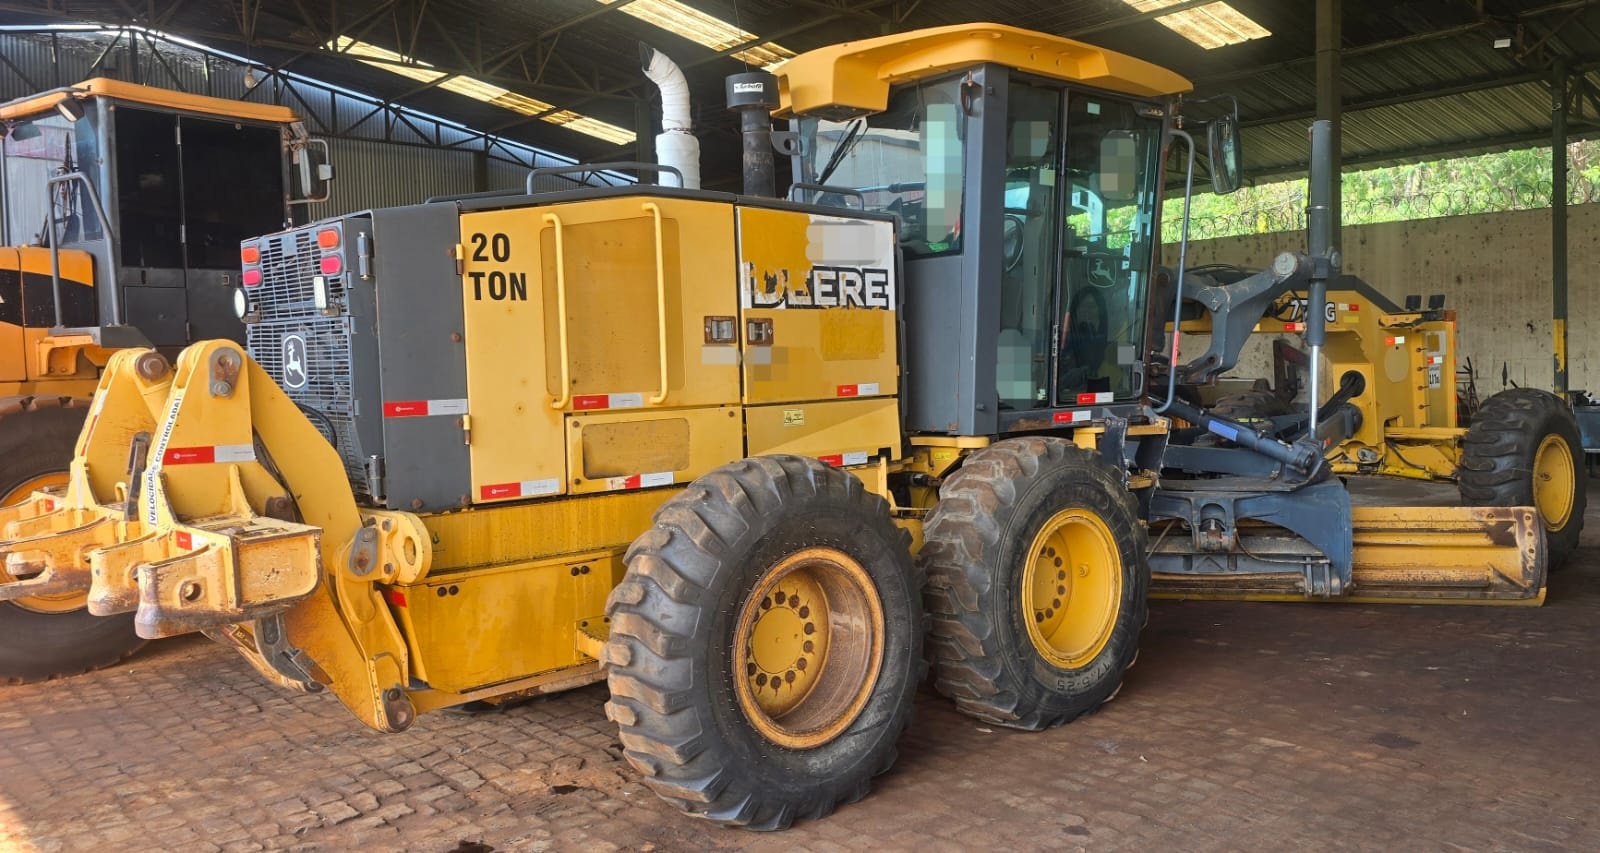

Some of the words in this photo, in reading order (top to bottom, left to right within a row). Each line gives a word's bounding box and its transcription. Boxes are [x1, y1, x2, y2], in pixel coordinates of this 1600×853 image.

[471, 233, 510, 262] 20
[468, 271, 527, 300] TON
[1289, 298, 1336, 323] 77G
[156, 402, 180, 462] CONTROLADA
